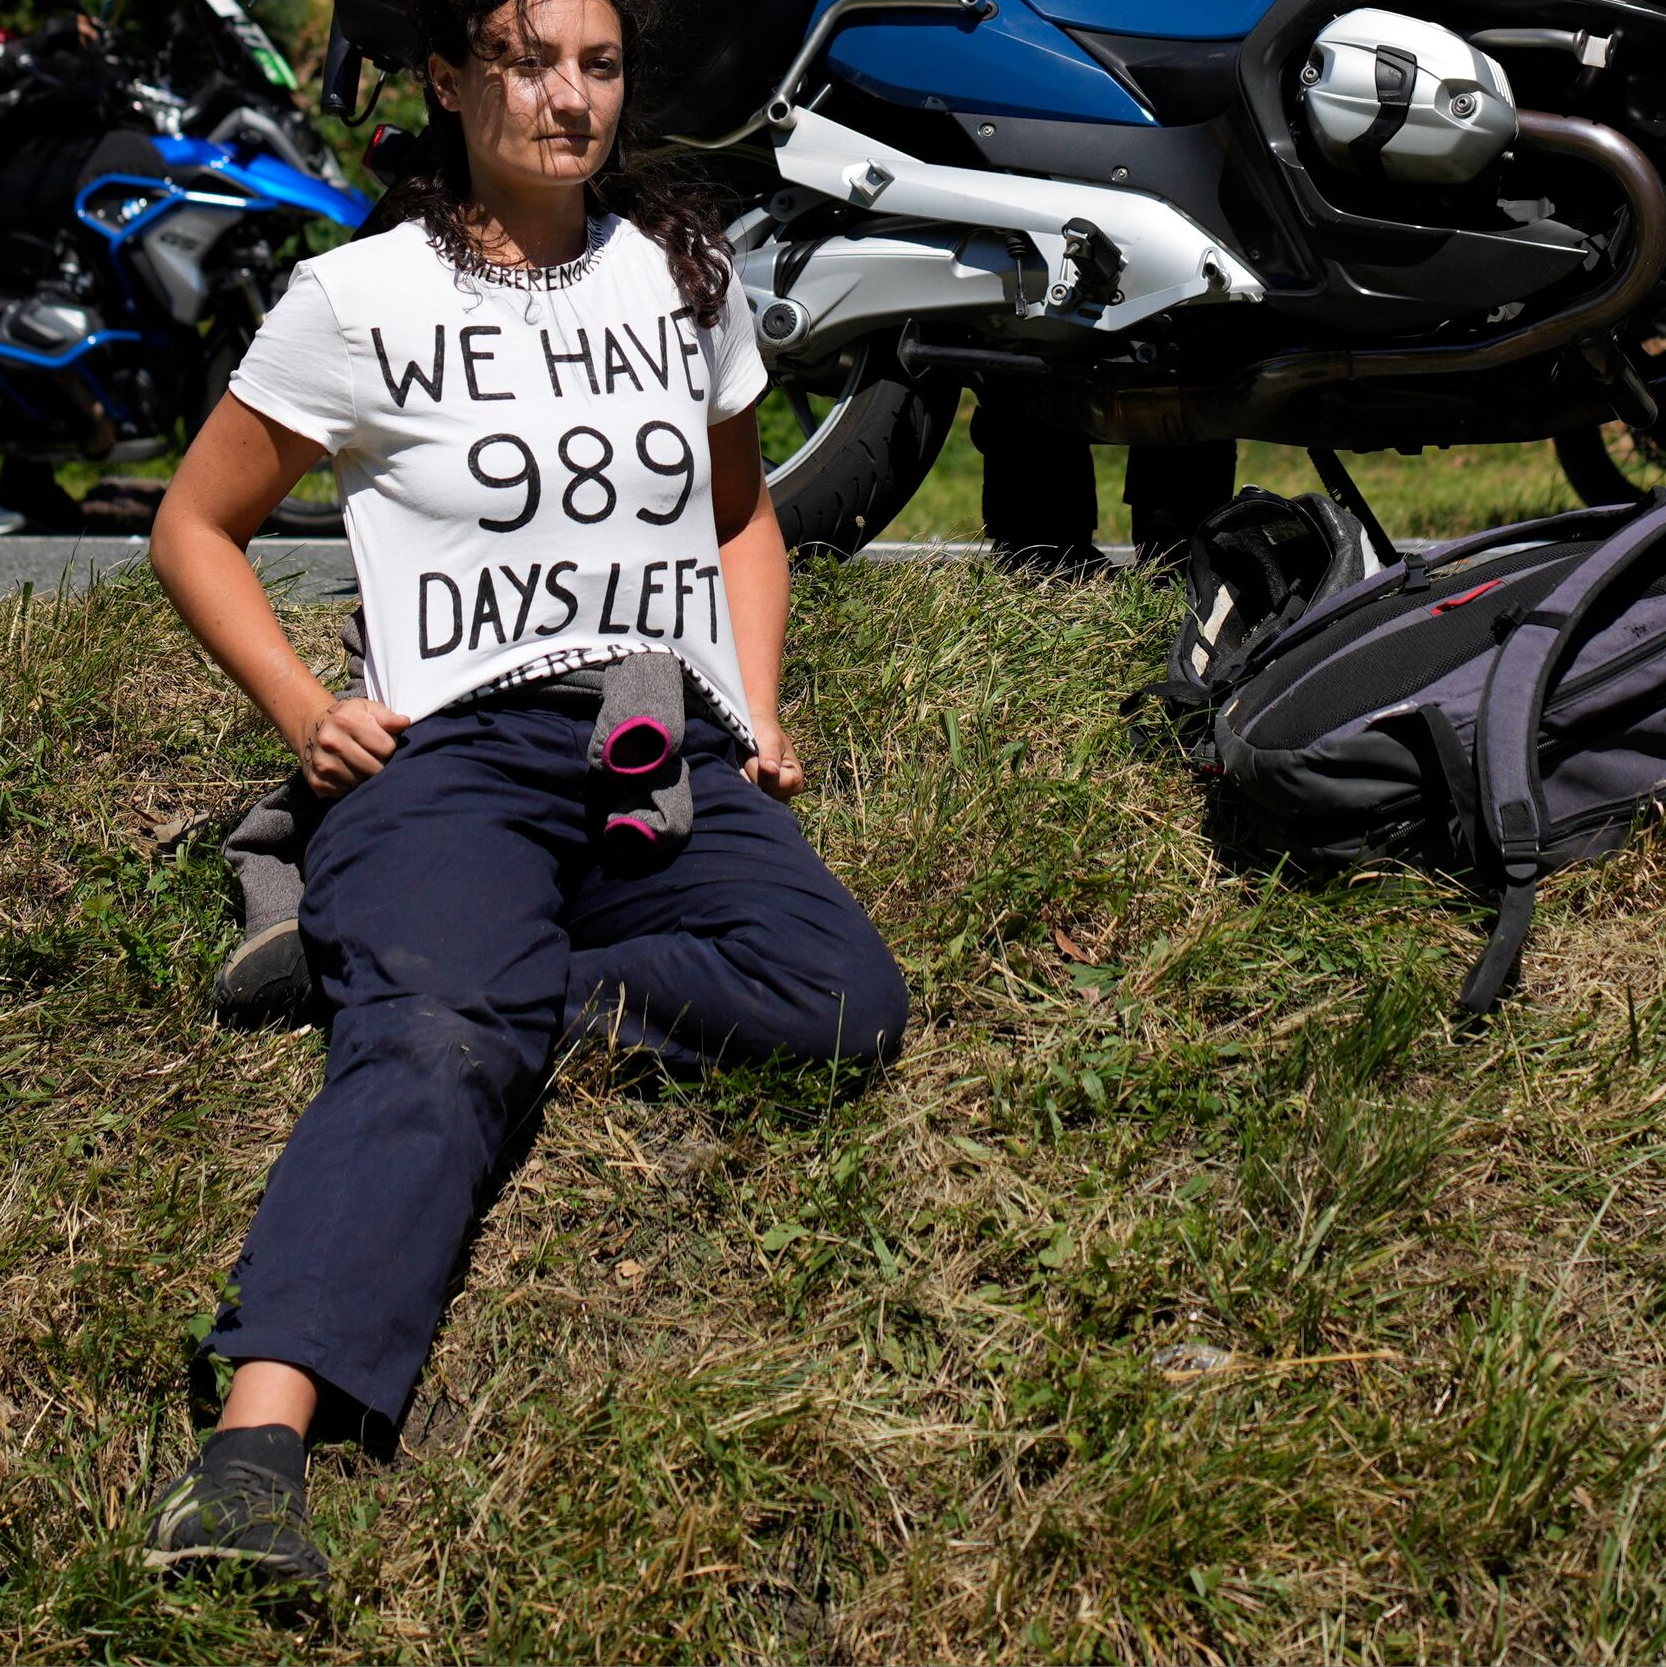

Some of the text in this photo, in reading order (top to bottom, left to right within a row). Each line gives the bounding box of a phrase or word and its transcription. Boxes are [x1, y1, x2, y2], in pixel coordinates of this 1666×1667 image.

[371, 305, 704, 408] WE HAVE
[467, 420, 694, 533] 989
[419, 558, 719, 659] DAYS LEFT
